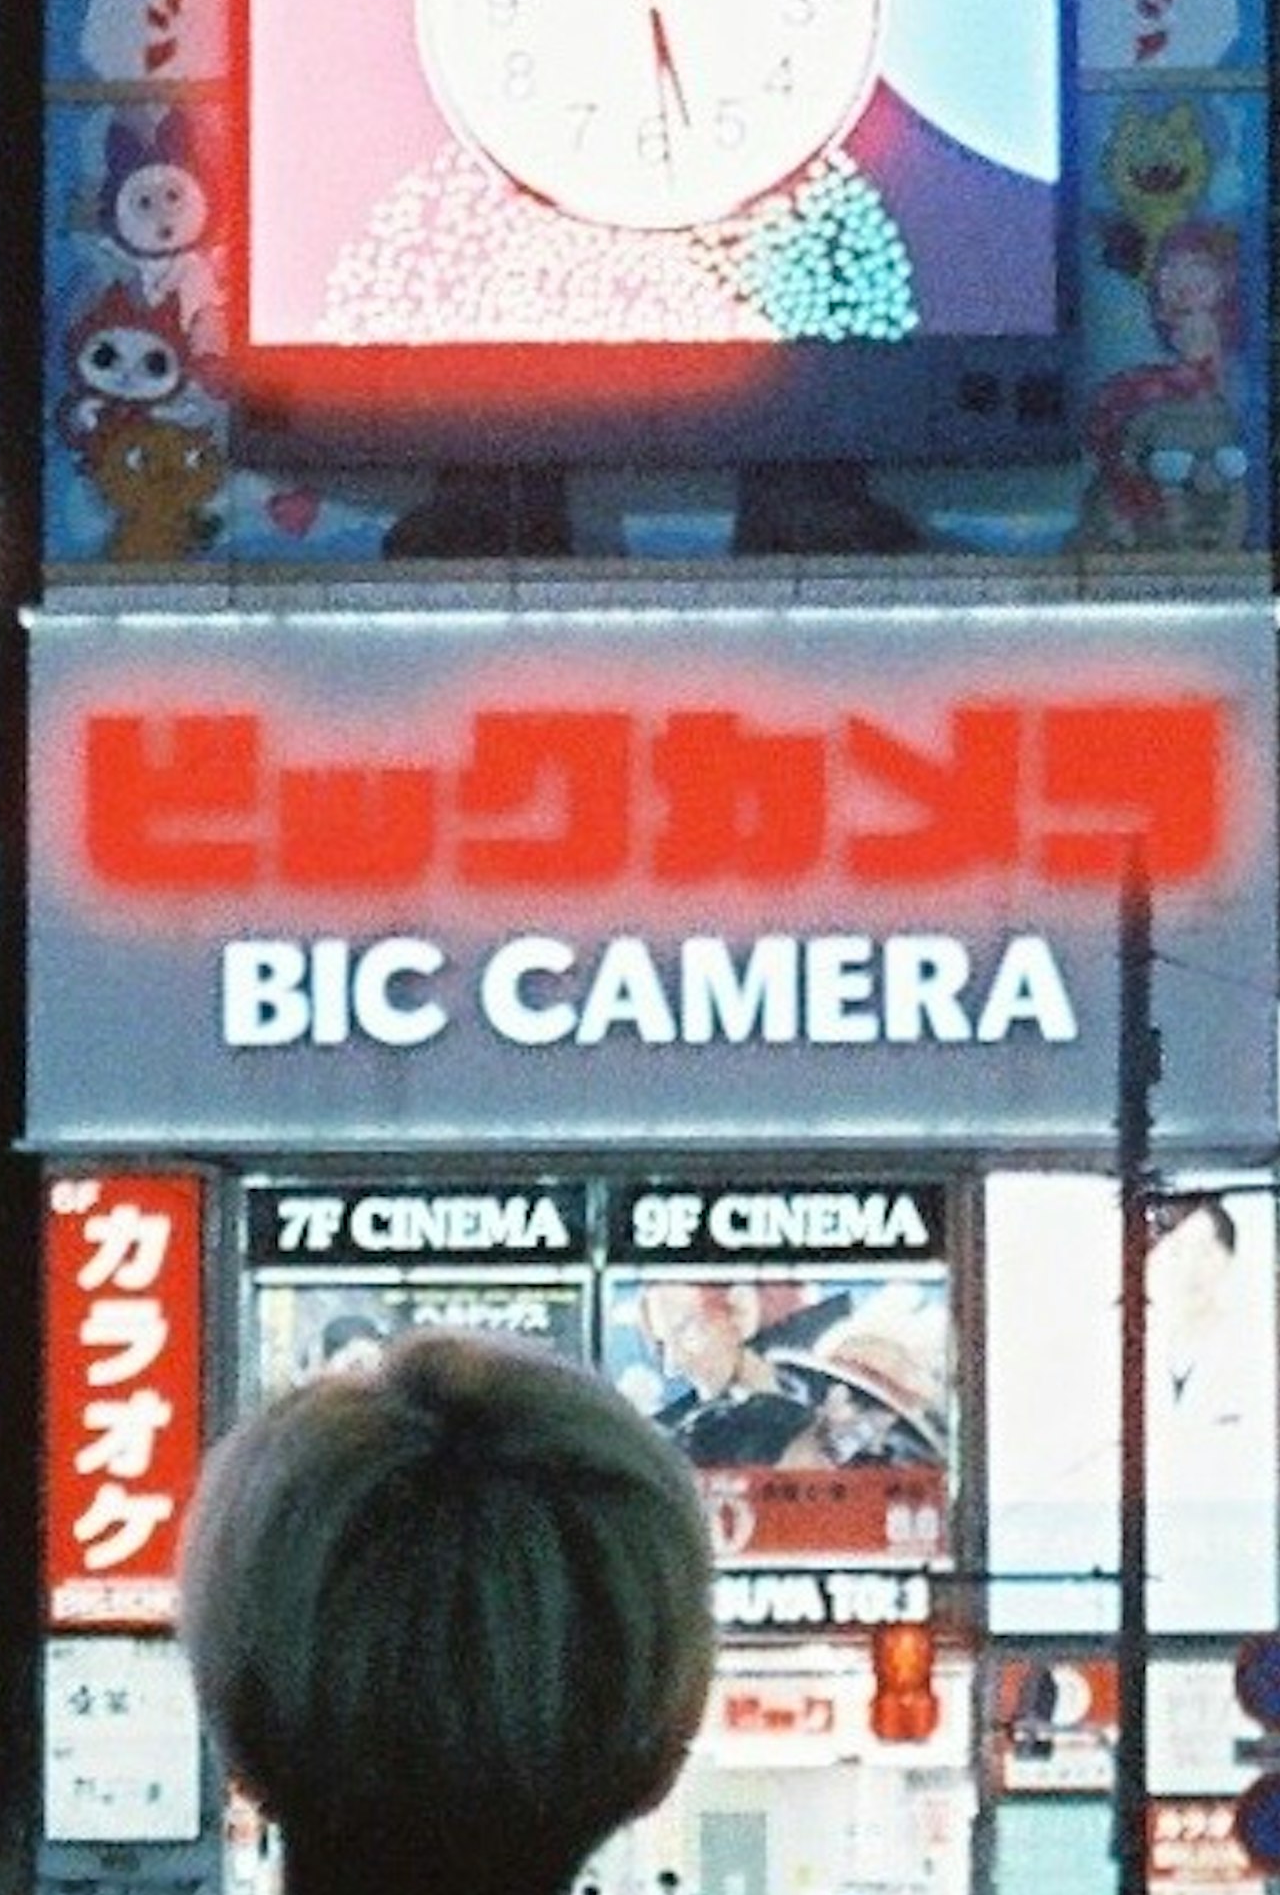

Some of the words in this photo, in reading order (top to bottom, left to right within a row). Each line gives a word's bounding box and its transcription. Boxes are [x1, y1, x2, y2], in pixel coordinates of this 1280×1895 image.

[86, 695, 1222, 892] ビックカメラ
[221, 939, 449, 1047] BIC
[481, 935, 1080, 1045] CAMERA
[276, 1196, 345, 1252] 7F
[350, 1195, 570, 1251] CINEMA
[709, 1194, 929, 1248] CINEMA
[70, 1202, 175, 1572] カラオケ
